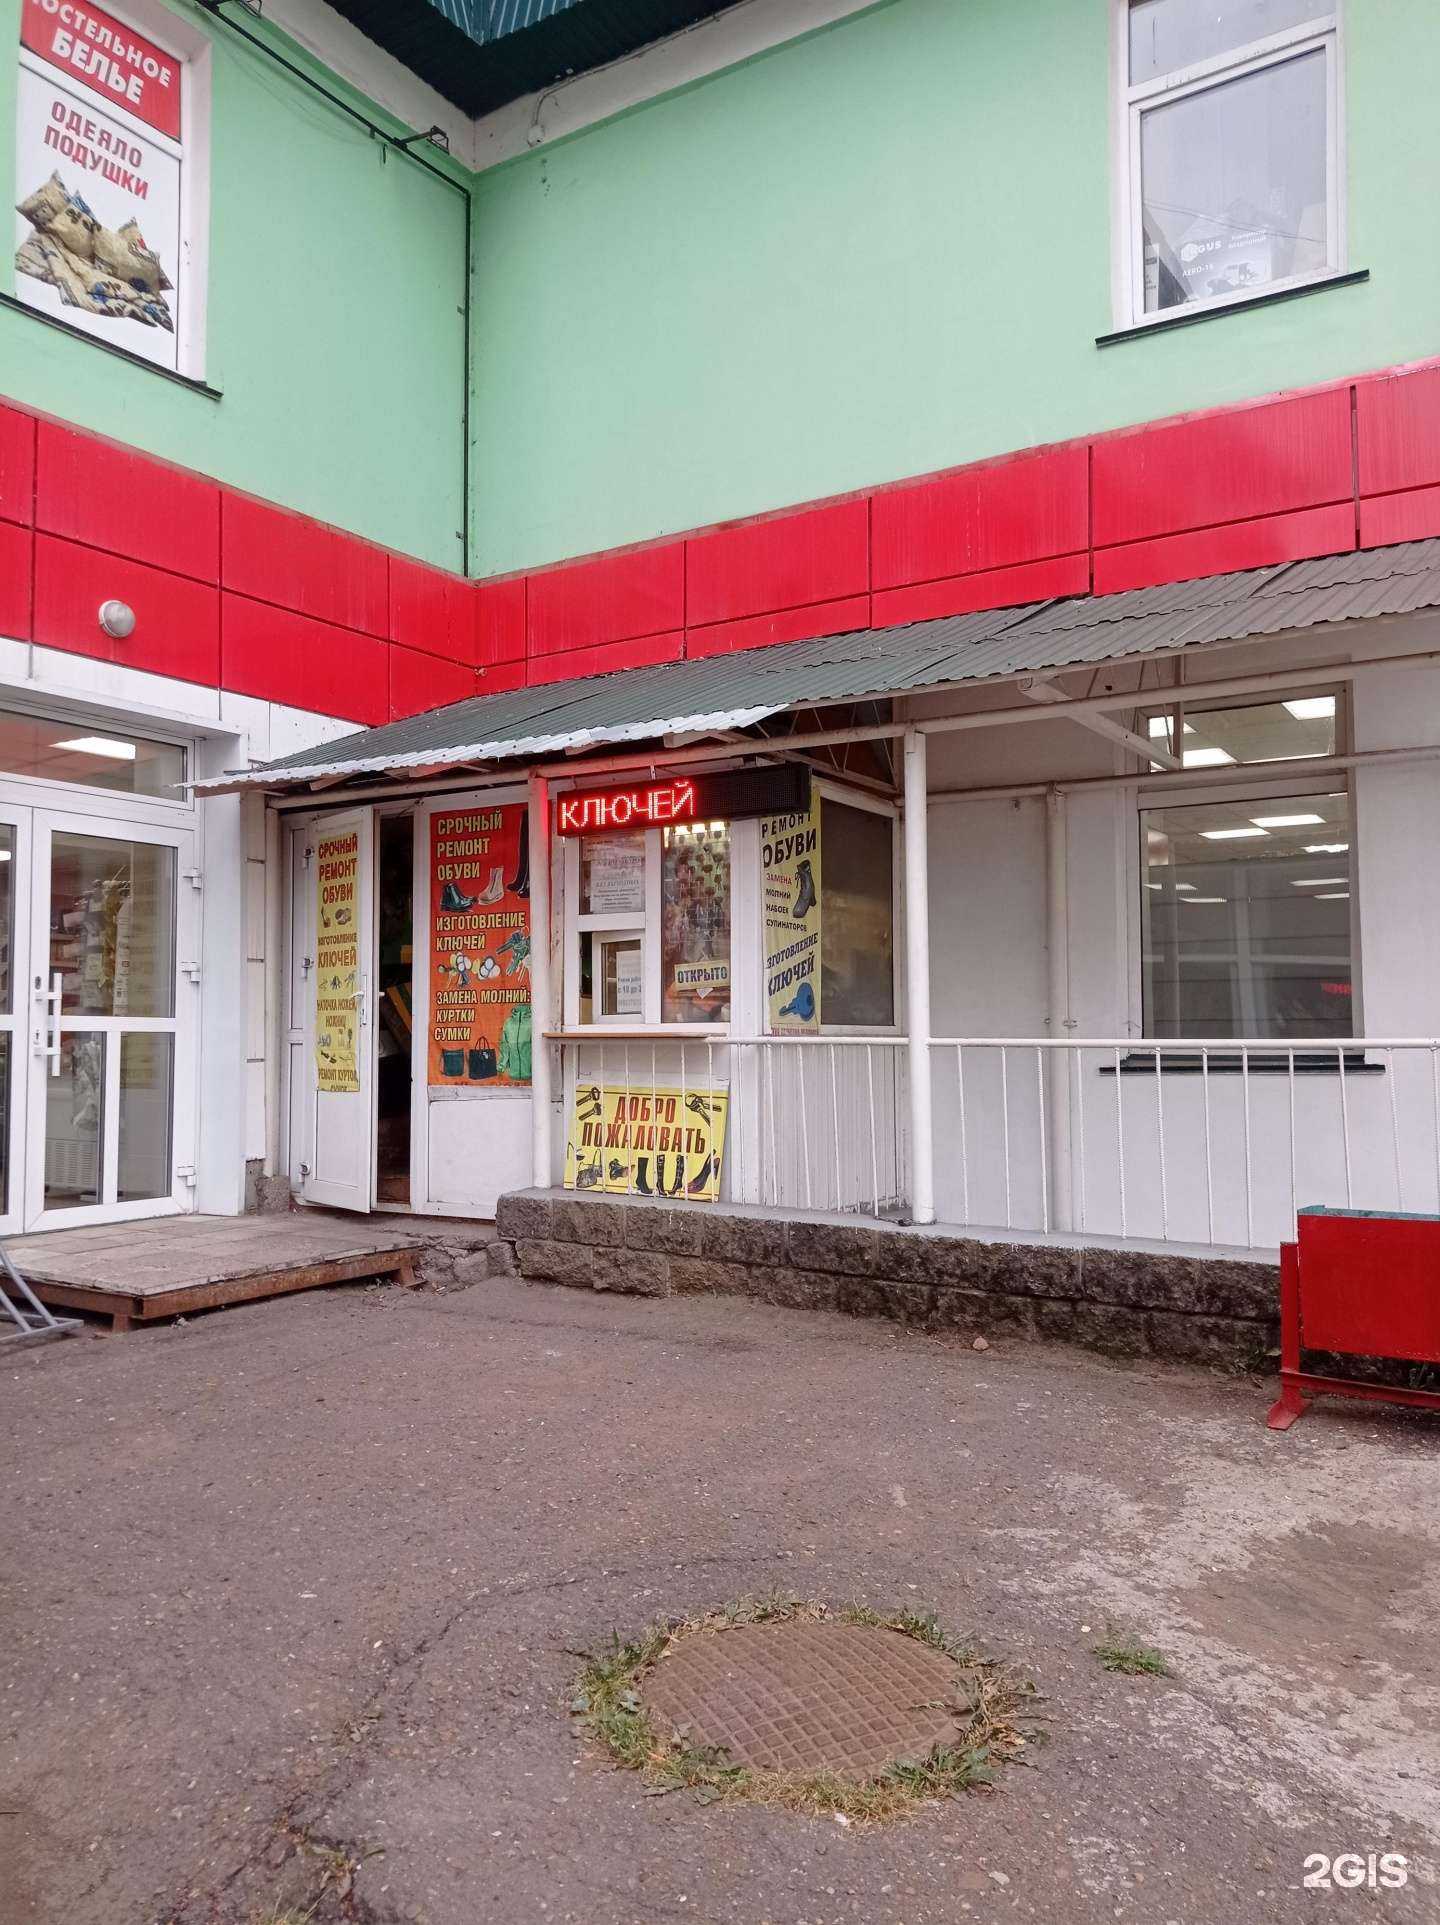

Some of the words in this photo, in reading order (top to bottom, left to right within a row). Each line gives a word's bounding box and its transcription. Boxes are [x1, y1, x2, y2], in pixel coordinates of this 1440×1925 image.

[31, 0, 171, 88] ОСТЕЛЬНОЕ
[51, 27, 144, 104] БЕЛЬЕ
[51, 101, 142, 168] ОДЕЯЛО
[44, 125, 149, 201] ПОДУШКИ
[562, 781, 693, 829] КЛЮЧЕЙ
[437, 807, 503, 835] СРОЧНЫЙ
[318, 833, 358, 860] СРОЧНЫЙ
[437, 838, 490, 858] РЕМОНТ
[763, 828, 817, 868] ОБУВИ
[319, 858, 357, 882] РЕМОНТ
[437, 862, 480, 881] ОБУВИ
[766, 873, 792, 885] ЗАМЕНА
[322, 883, 353, 904] ОБУВИ
[766, 888, 791, 900] МОЛНИЙ
[766, 904, 789, 914] НАБОЕК
[436, 912, 526, 931] ИЗГОТОВЛЕНИЕ
[766, 919, 807, 932] СУПИНАТОРОВ
[436, 931, 486, 951] КЛЮЧЕЙ
[767, 932, 819, 969] ЗГОТОВЛЕНИЕ
[318, 946, 357, 968] КЛЮЧЕЙ
[677, 966, 728, 984] ОТКРЫТО
[437, 990, 478, 1005] ЗАМЕНА
[481, 987, 532, 1004] МОЛНИЙ:
[436, 1008, 475, 1022] КУРТКИ
[434, 1027, 471, 1040] СУМКИ
[614, 1096, 676, 1123] ДОБРО
[582, 1122, 706, 1154] ПОЖАЛОВАТЬ
